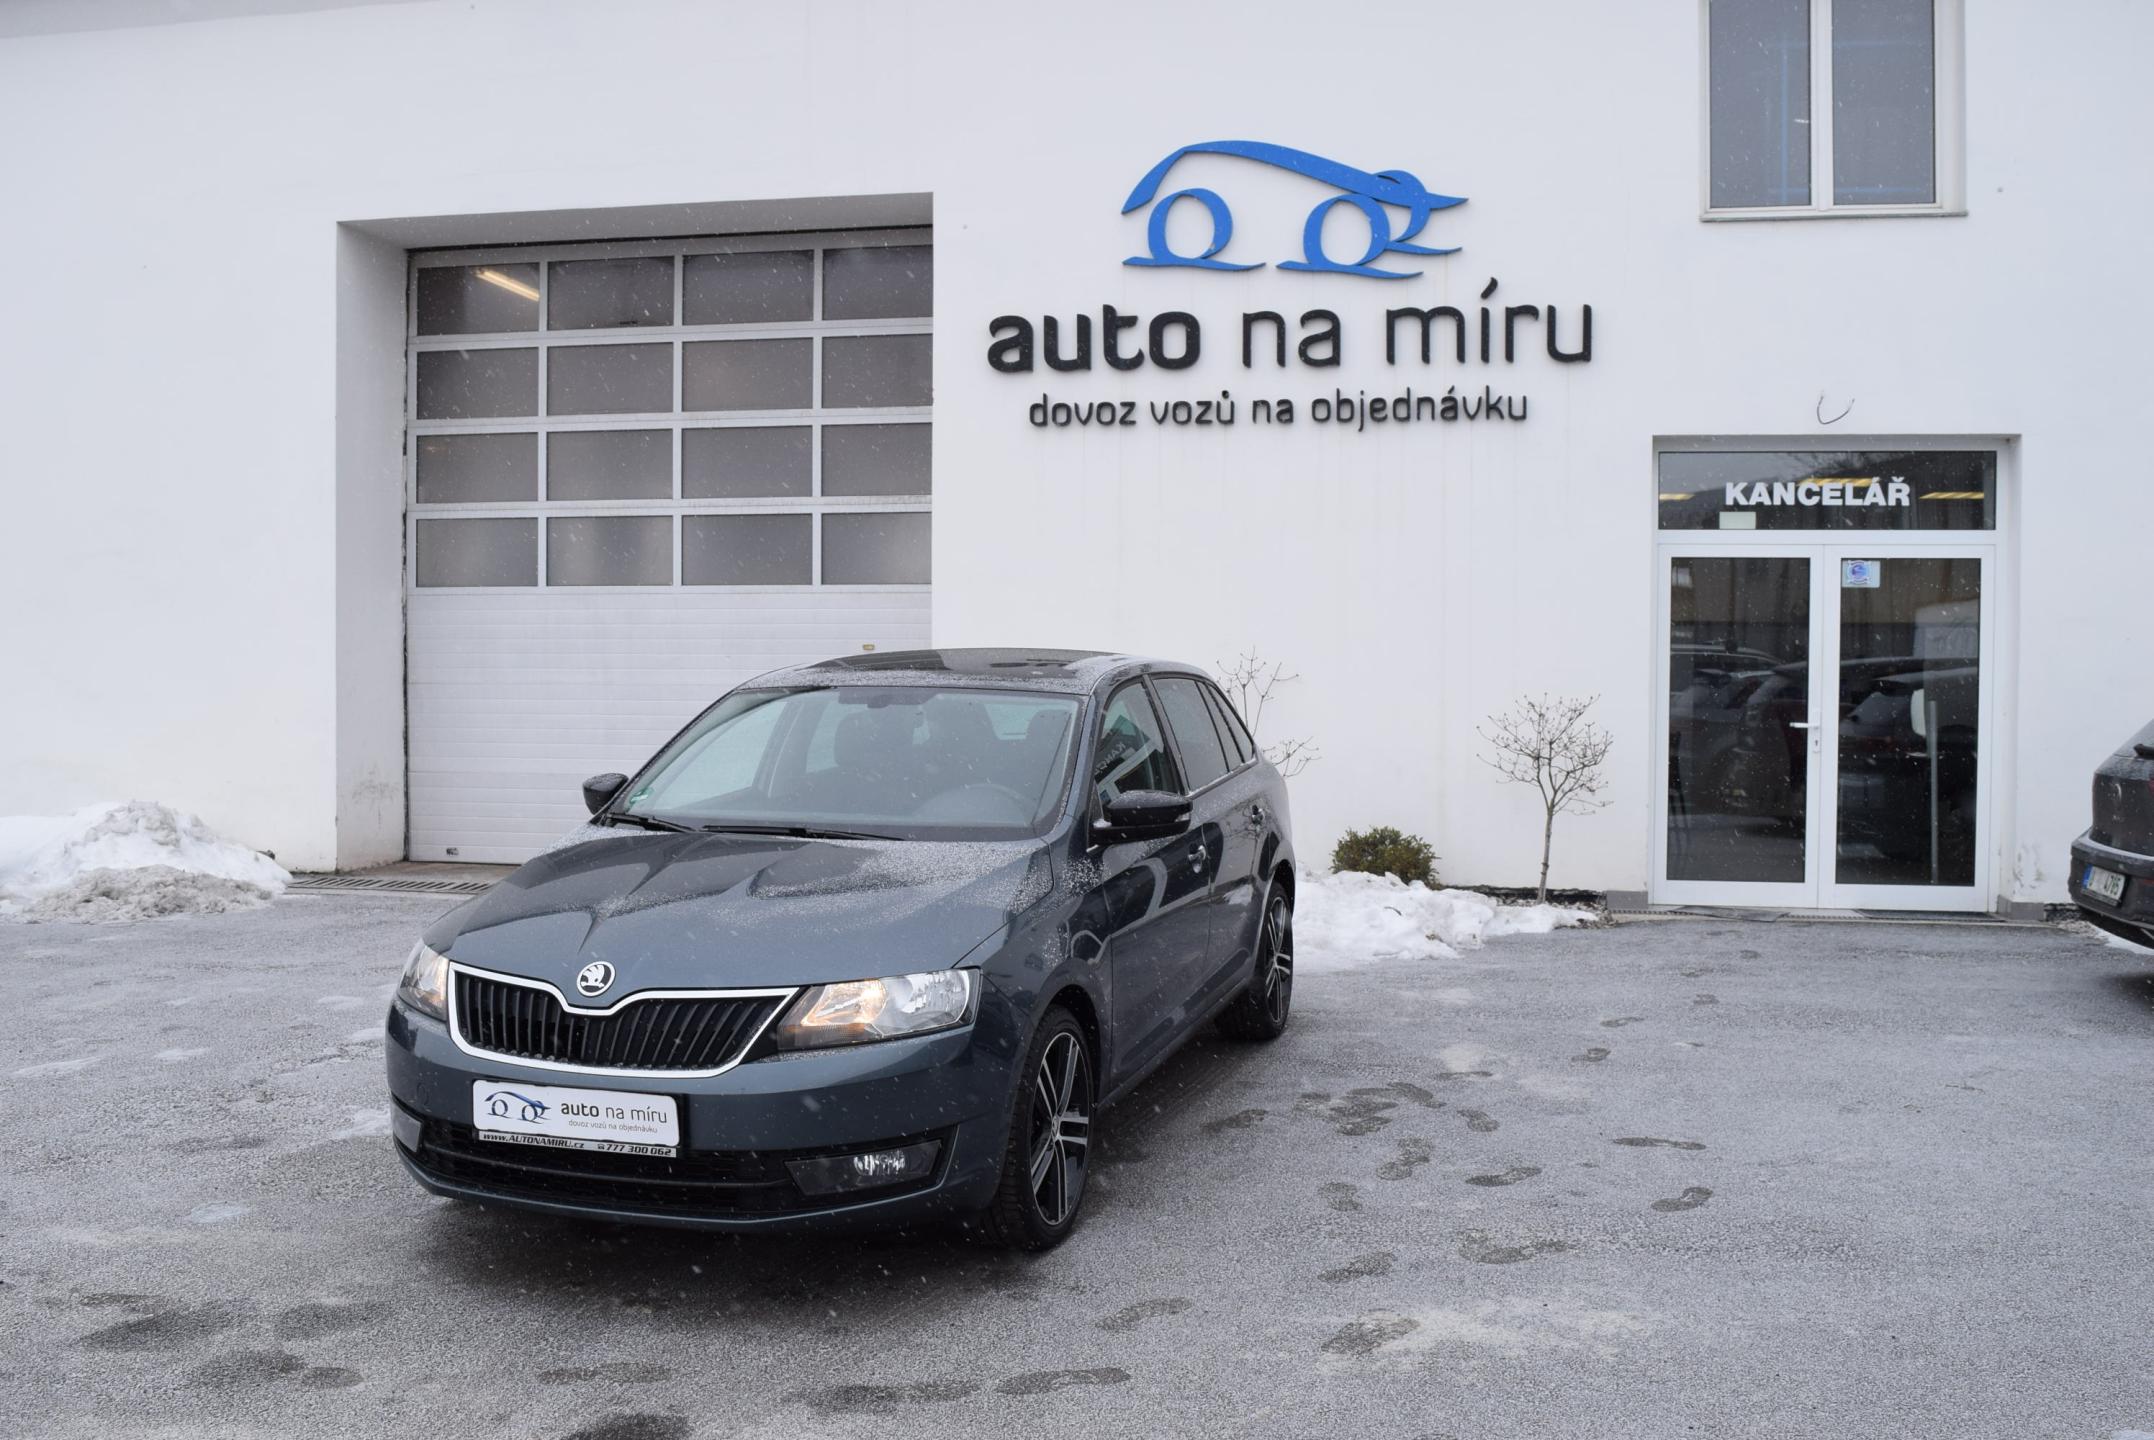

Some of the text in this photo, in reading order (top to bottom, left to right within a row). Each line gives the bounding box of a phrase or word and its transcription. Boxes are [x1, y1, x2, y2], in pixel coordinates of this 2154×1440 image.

[987, 277, 1593, 373] auto na míru
[1030, 384, 1528, 433] dovoz vozů na objednávku
[1724, 476, 1910, 507] KANCELÁŘ
[560, 1102, 668, 1124] auto na míru
[568, 1119, 589, 1128] dovoz
[618, 1122, 658, 1134] objednávku
[482, 1133, 672, 1156] www.AUTONAMIRU.cz 777 300 062
